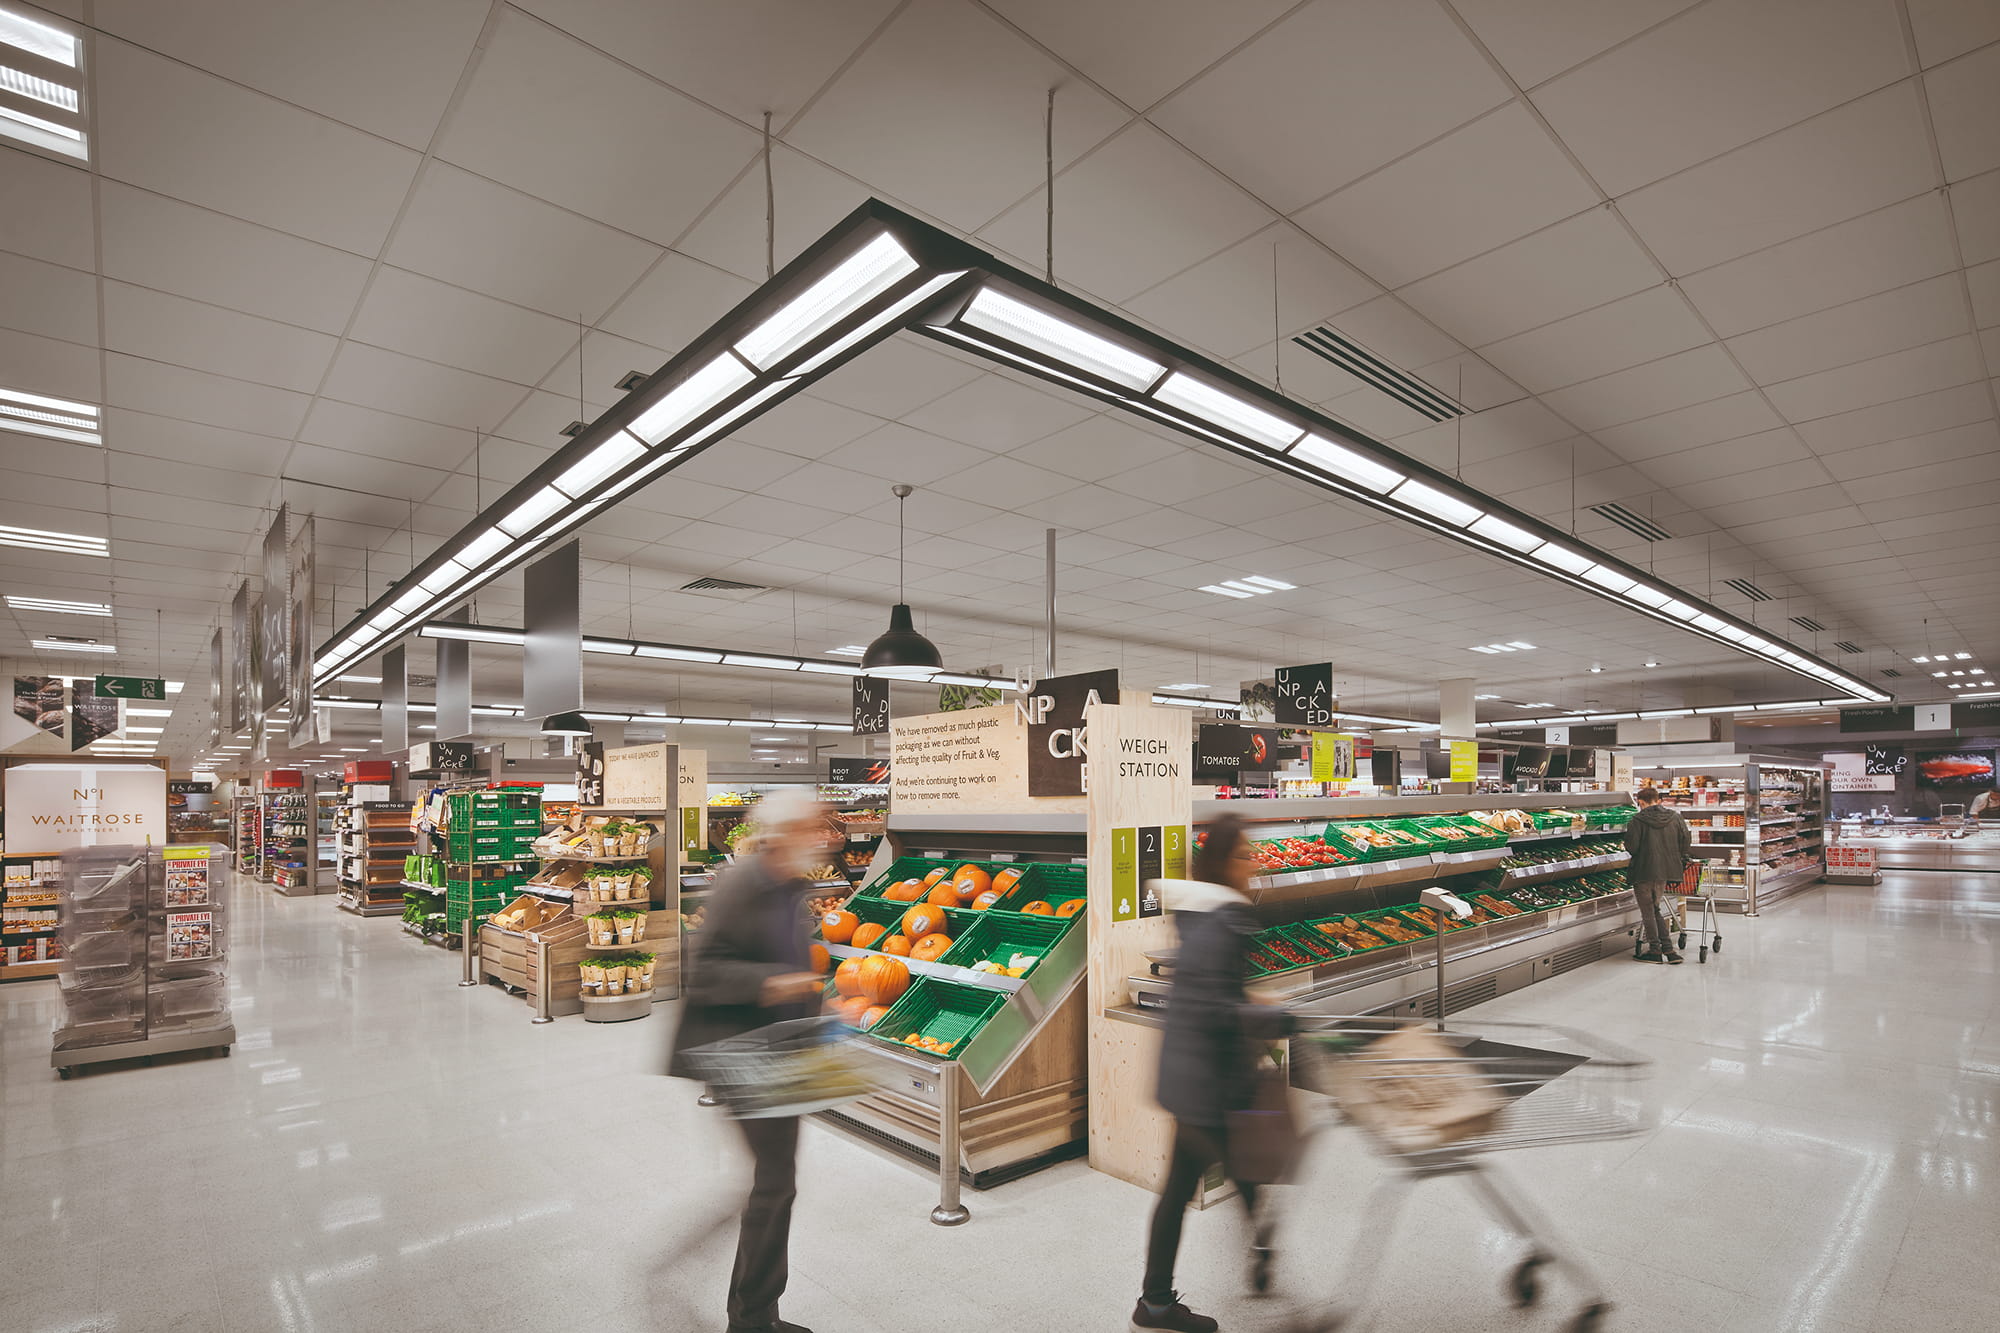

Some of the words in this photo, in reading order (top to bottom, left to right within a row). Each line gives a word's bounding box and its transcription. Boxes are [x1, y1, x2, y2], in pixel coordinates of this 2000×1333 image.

[74, 703, 116, 712] WAITROSE
[1861, 709, 1884, 717] Poultry
[1930, 712, 1936, 723] 1
[895, 727, 906, 737] We
[907, 727, 920, 736] have
[921, 722, 948, 734] removed
[957, 720, 976, 730] much
[977, 717, 999, 731] plastic
[1554, 733, 1561, 742] 2
[895, 741, 923, 753] packaging
[955, 735, 981, 746] without
[1119, 738, 1168, 754] WEIGH
[895, 755, 920, 766] affecting
[920, 754, 931, 763] the
[932, 753, 953, 764] quality
[953, 750, 961, 760] of
[962, 750, 977, 760] Fruit
[979, 749, 985, 759] &
[1202, 756, 1240, 766] TOMATOES
[1119, 762, 1179, 777] STATION
[1515, 765, 1538, 774] AVOCADO
[895, 777, 908, 787] And
[926, 775, 958, 787] continuing
[958, 776, 967, 784] to
[968, 774, 986, 783] work
[987, 775, 997, 783] on
[895, 791, 909, 800] how
[909, 791, 917, 800] to
[918, 792, 941, 800] remove
[941, 791, 961, 800] more.
[32, 813, 144, 825] WAITROSE
[689, 810, 695, 820] 3
[1120, 835, 1126, 855] 1
[1145, 833, 1155, 853] 2
[1171, 832, 1179, 851] 3
[172, 860, 197, 869] PRIVATE
[175, 913, 199, 922] PRIVATE
[200, 912, 210, 921] EYE
